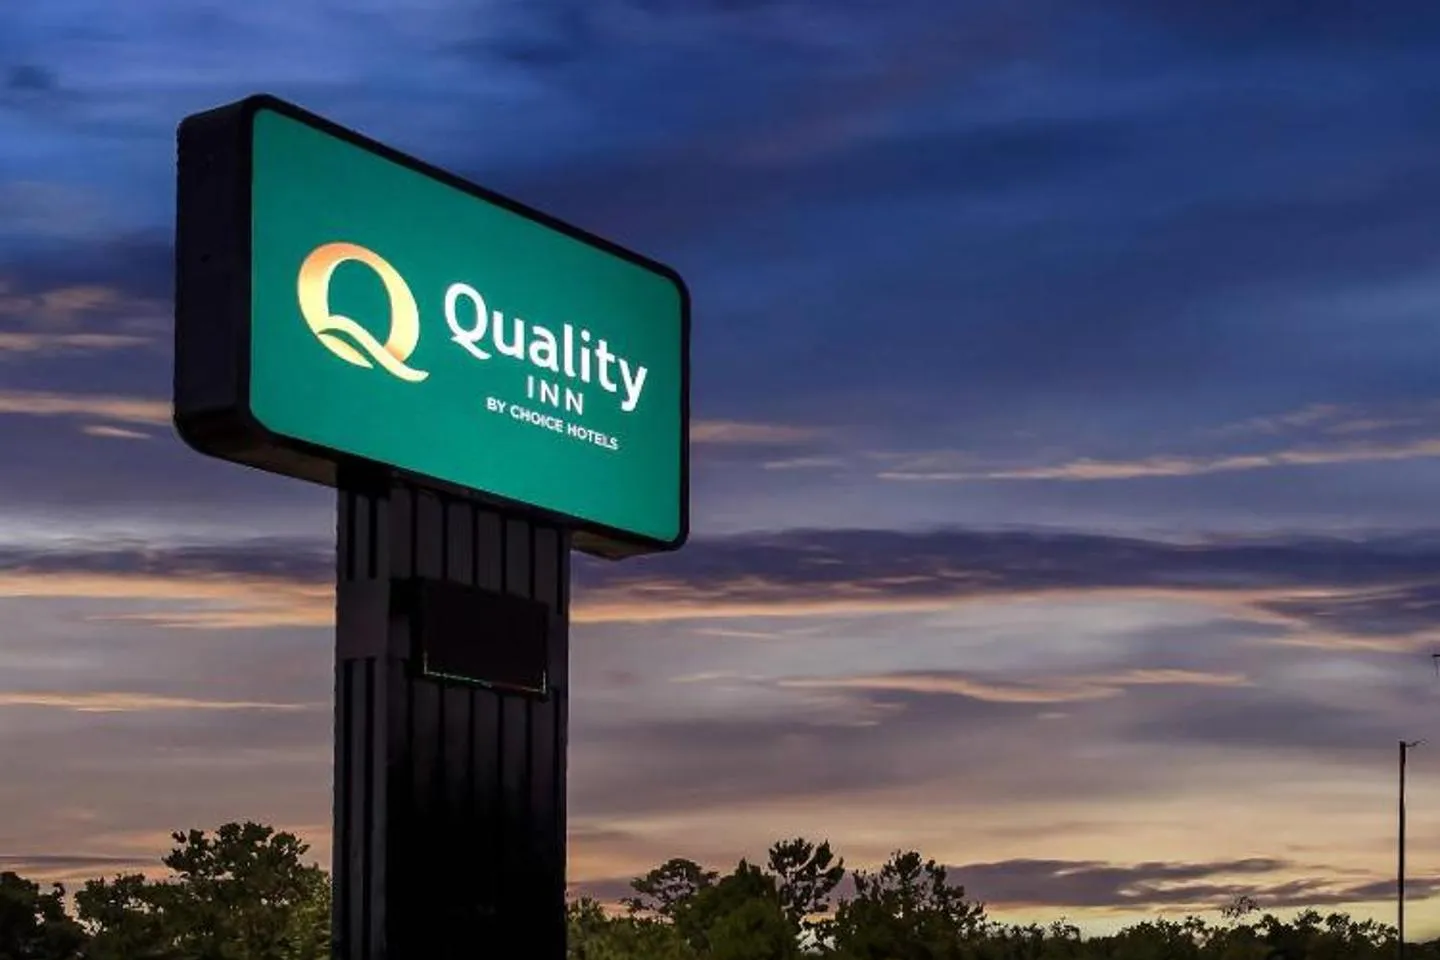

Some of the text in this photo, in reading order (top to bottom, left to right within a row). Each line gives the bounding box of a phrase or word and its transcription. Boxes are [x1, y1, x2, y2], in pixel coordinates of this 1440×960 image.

[296, 241, 430, 383] Q
[444, 282, 648, 412] Quality
[486, 396, 618, 450] BY CHOICE HOTELS
[527, 375, 584, 416] INN
